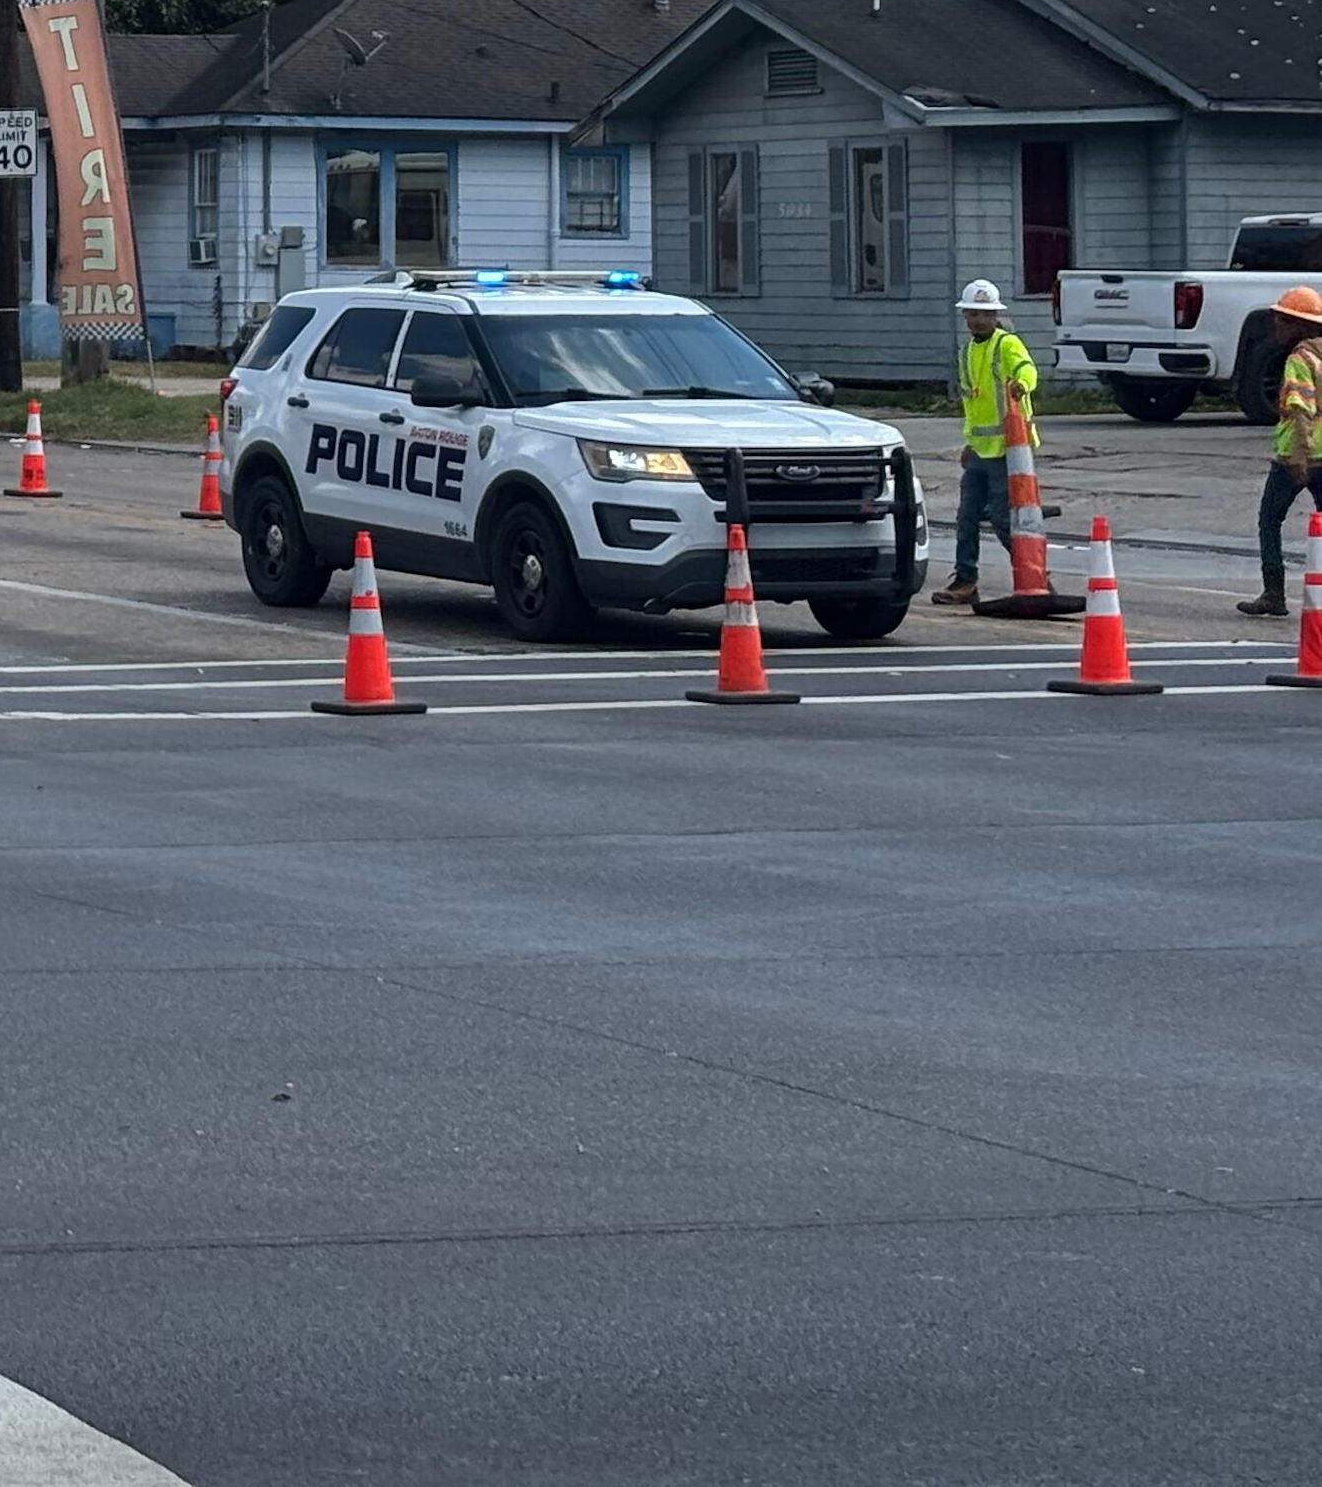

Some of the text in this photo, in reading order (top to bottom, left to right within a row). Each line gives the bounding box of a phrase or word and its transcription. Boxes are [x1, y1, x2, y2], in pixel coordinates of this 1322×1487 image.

[1094, 290, 1130, 300] GMC
[410, 425, 469, 447] BATON ROUGE
[305, 423, 468, 503] POLICE
